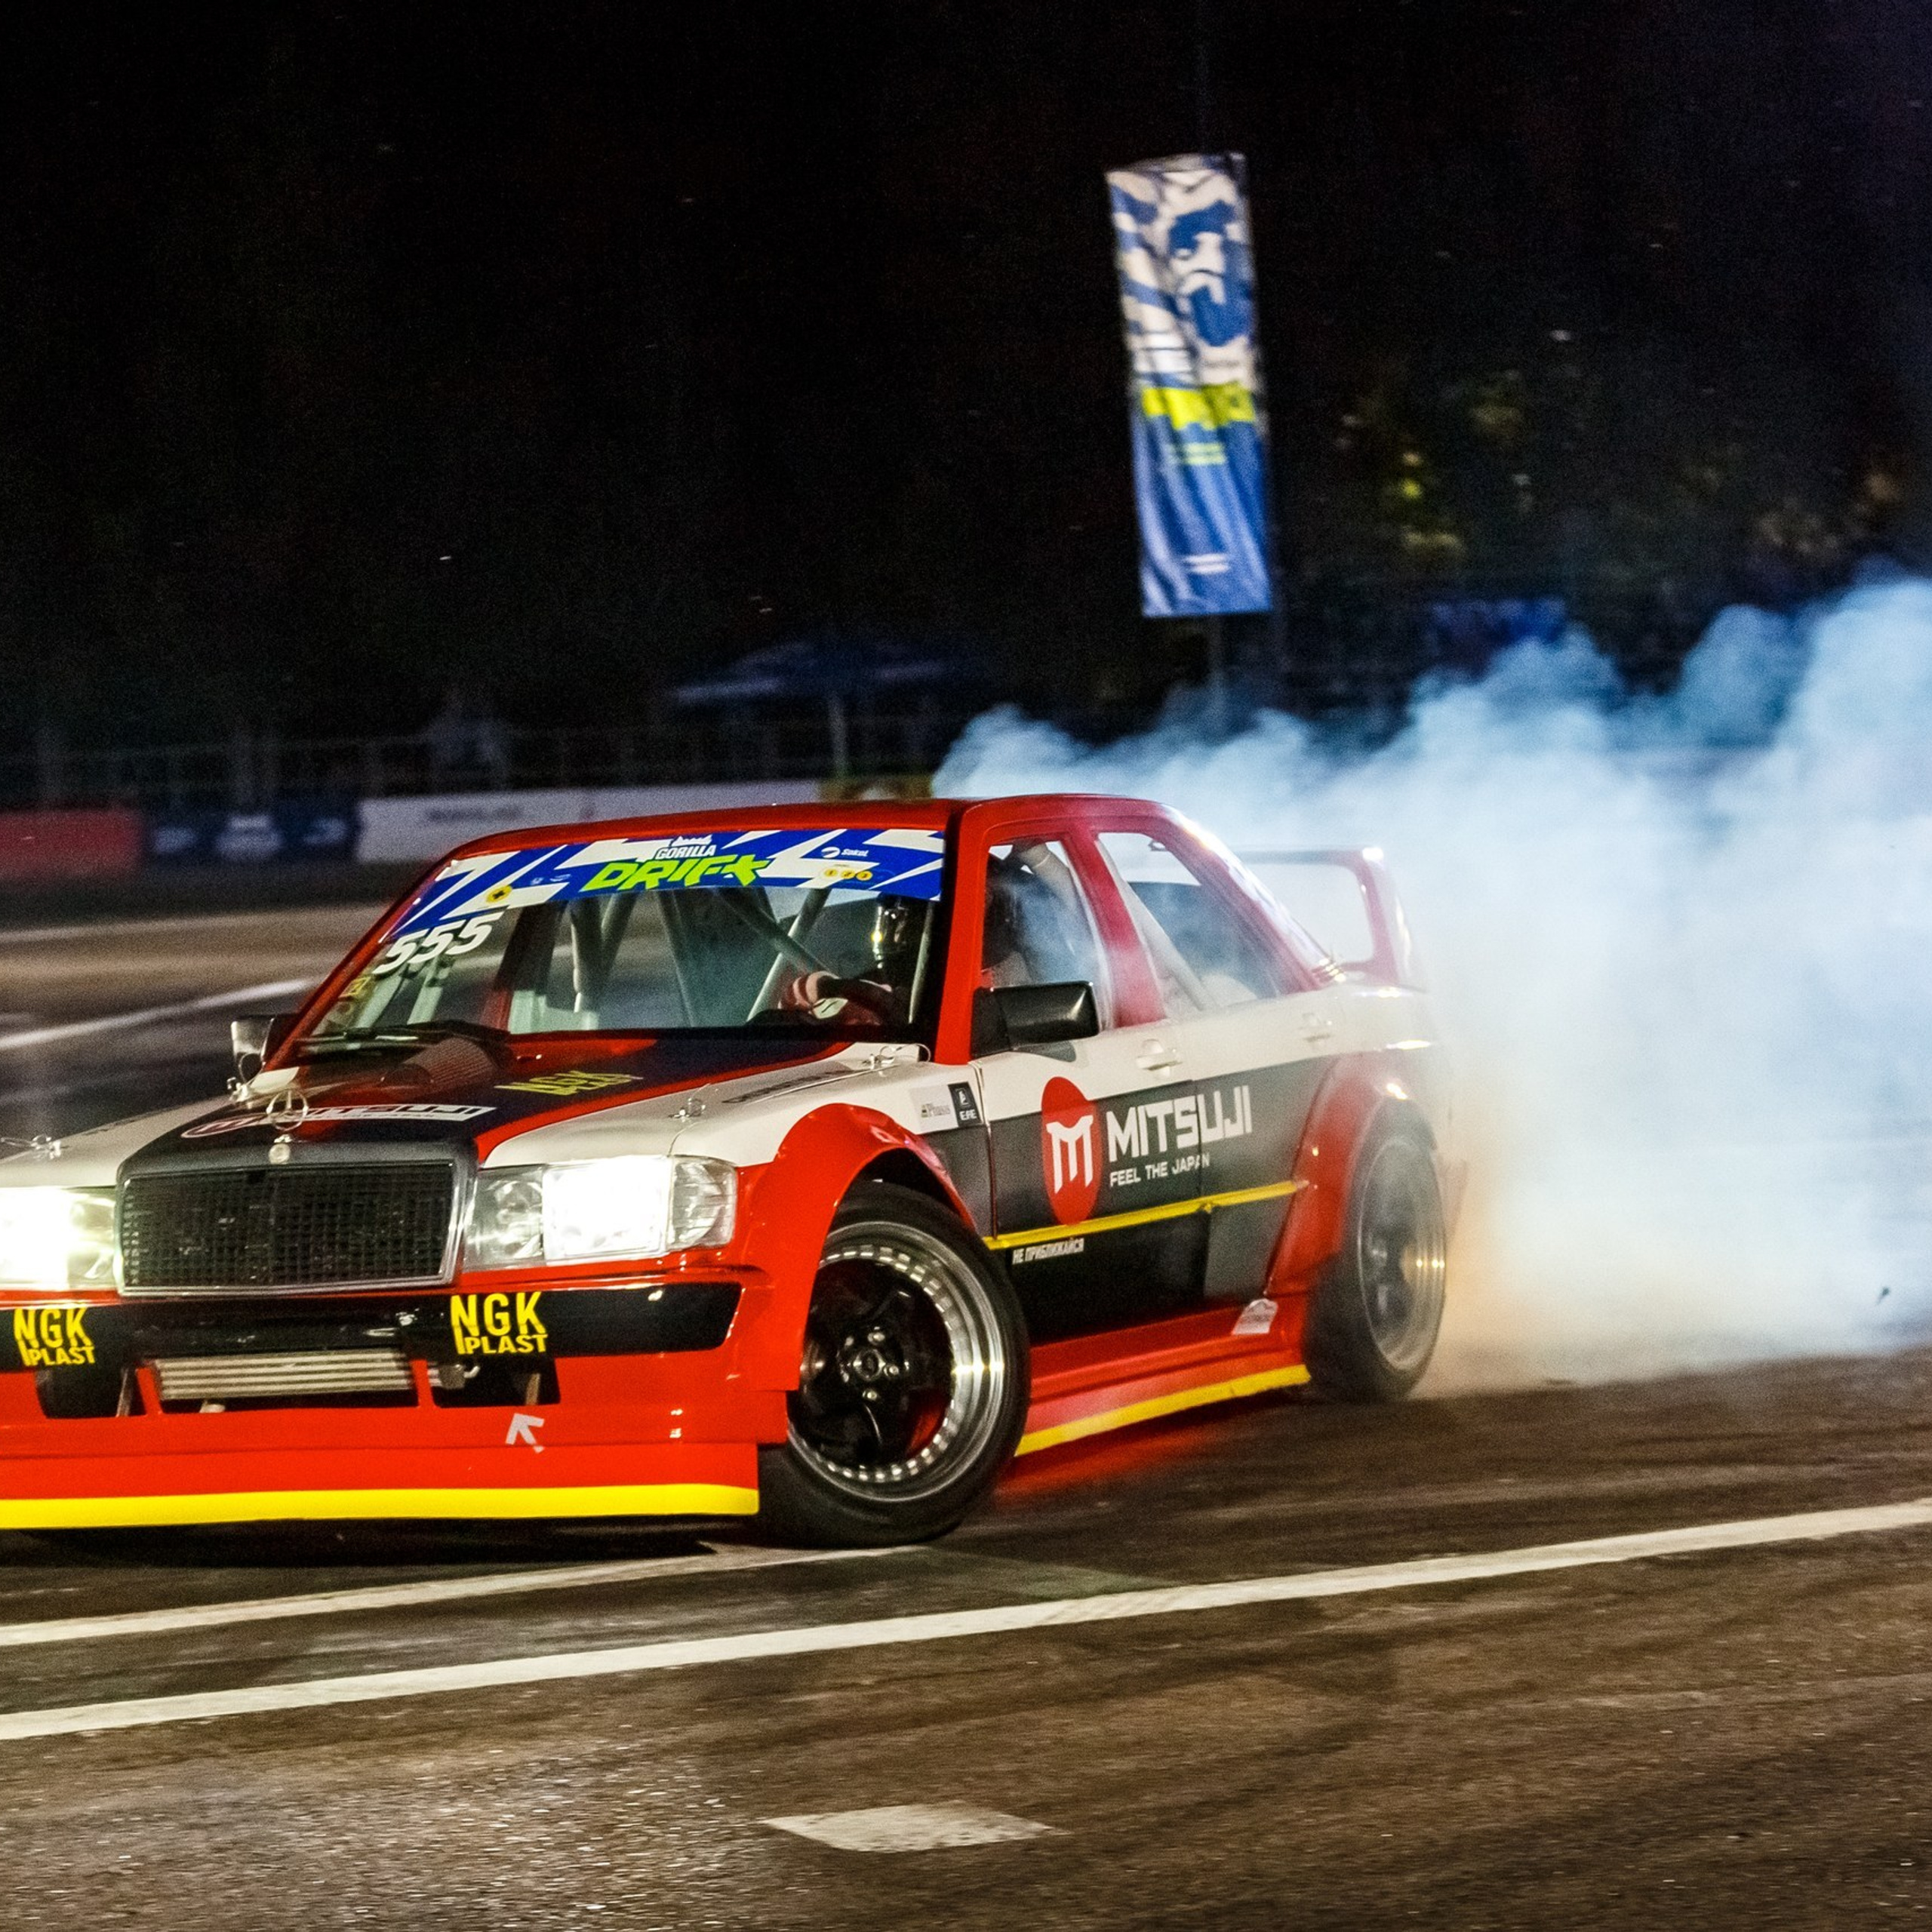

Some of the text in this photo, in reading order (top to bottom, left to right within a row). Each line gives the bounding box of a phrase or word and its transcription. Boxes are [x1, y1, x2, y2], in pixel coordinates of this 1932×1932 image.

[656, 844, 716, 860] GORILLA
[579, 854, 770, 893] DRIFT
[372, 912, 505, 974] 555
[1106, 1085, 1253, 1163] MITSUJI
[1110, 1153, 1211, 1187] FEEL THE JAPAN
[14, 1306, 94, 1366] NGK
[451, 1291, 547, 1355] NGK
[27, 1346, 95, 1366] PLAST
[464, 1334, 549, 1355] PLAST
